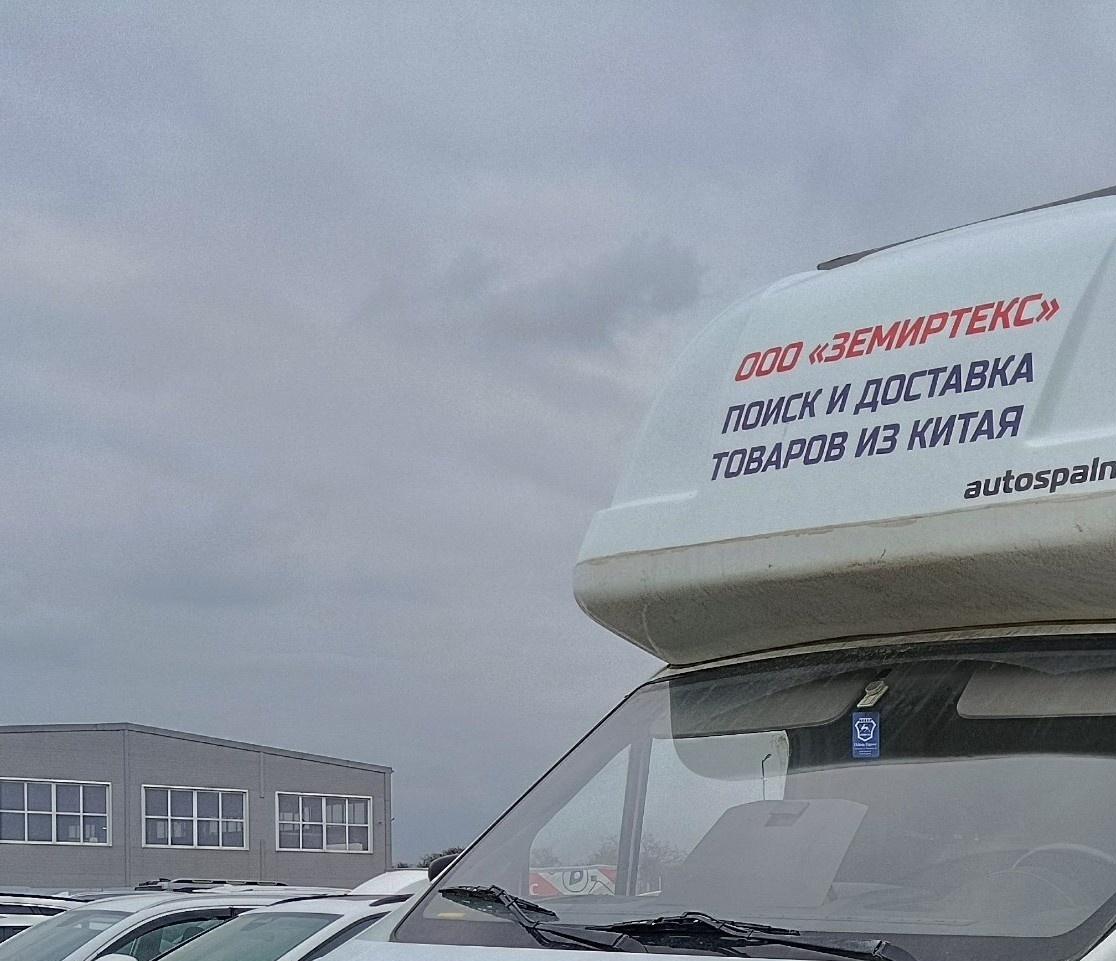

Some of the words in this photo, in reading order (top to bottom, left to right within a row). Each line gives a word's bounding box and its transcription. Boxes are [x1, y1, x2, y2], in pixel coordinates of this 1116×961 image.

[734, 341, 804, 382] ООО
[808, 293, 1061, 366] «ЗЕМИРТЕКС»
[721, 385, 823, 434] ПОИСК
[826, 384, 852, 415] И
[853, 352, 1035, 415] ДОСТАВКА
[711, 431, 847, 481] ТОВАРОВ
[854, 422, 898, 459] ИЗ
[906, 405, 1025, 452] КИТАЯ
